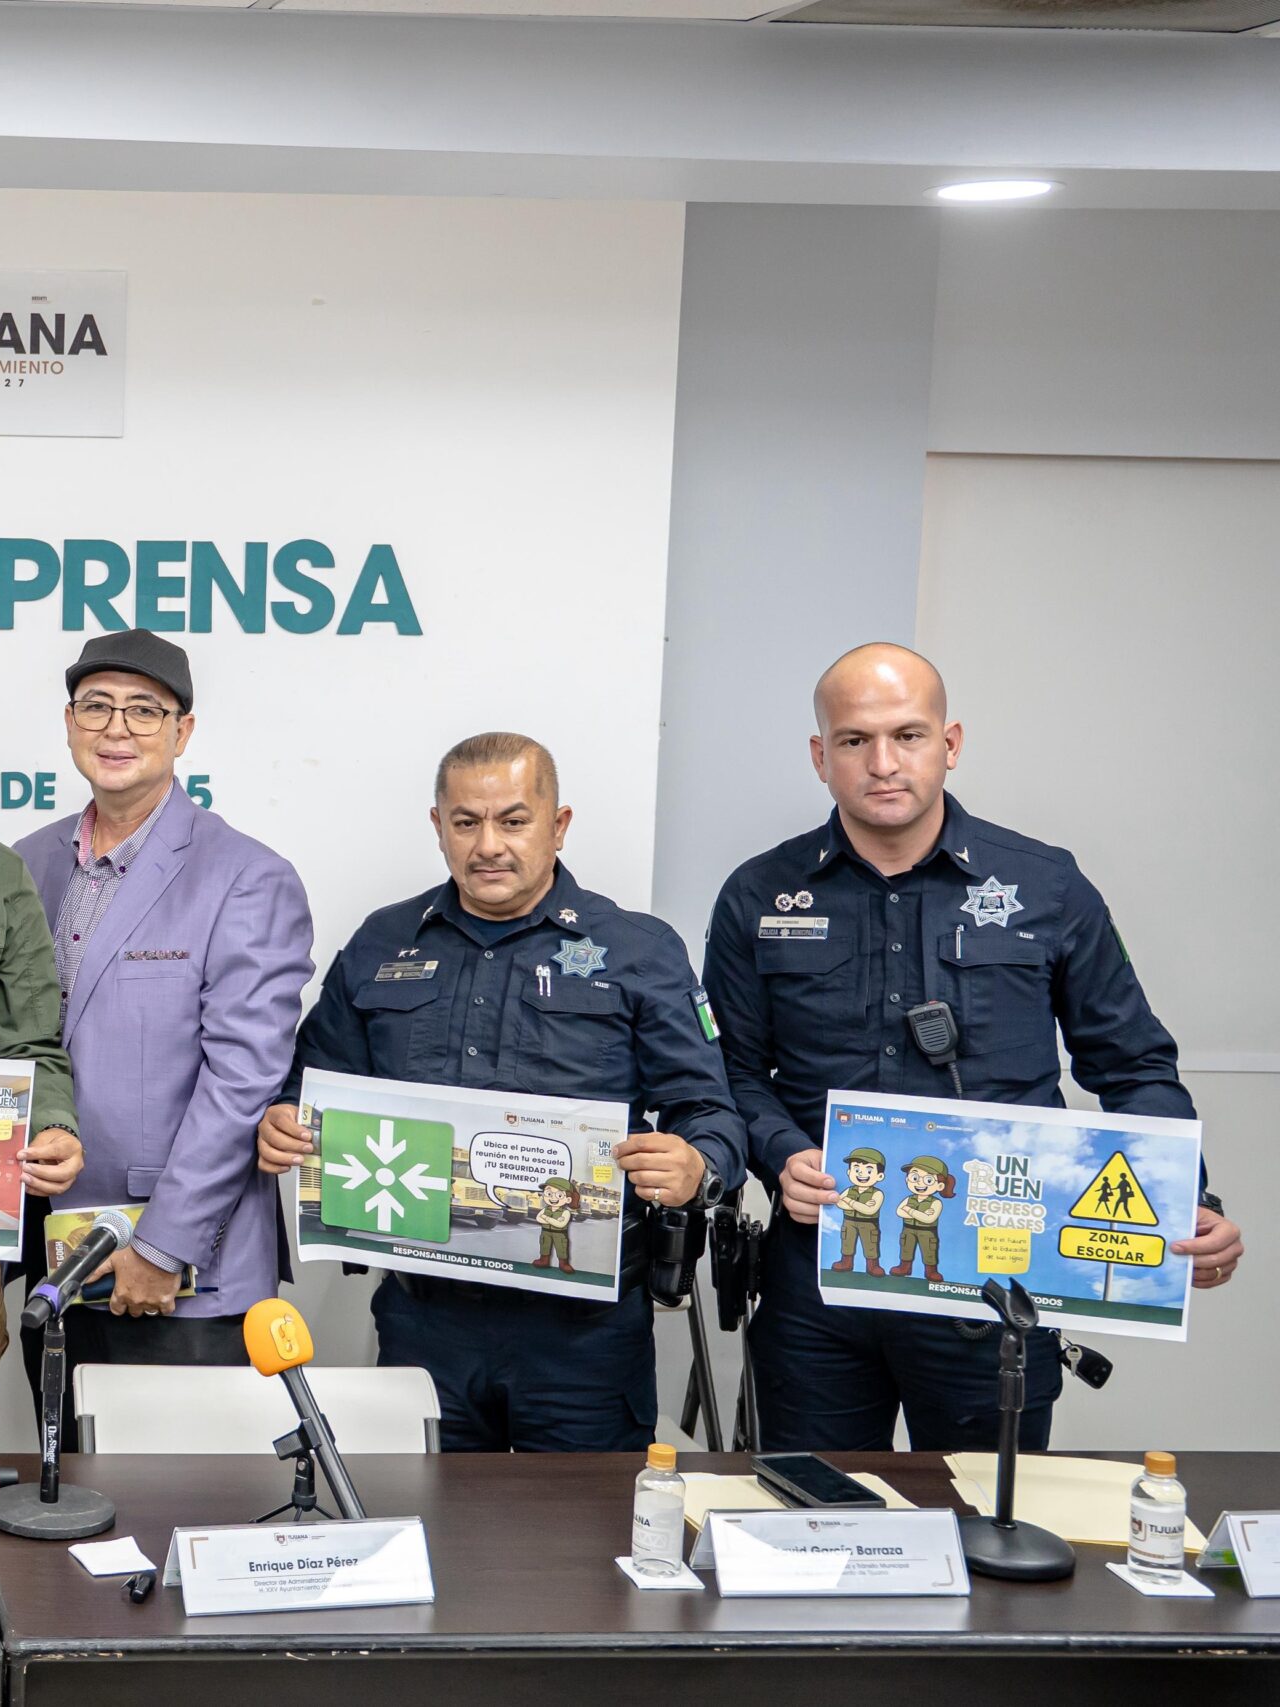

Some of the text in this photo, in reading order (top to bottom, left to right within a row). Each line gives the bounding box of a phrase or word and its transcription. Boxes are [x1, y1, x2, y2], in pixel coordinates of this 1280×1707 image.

[0, 771, 56, 809] DE
[520, 1116, 545, 1124] TIJUANA
[854, 1114, 884, 1123] TIJUANA
[483, 1141, 508, 1149] Ubica
[520, 1146, 544, 1154] punto
[475, 1150, 506, 1159] reunión
[532, 1157, 565, 1166] escuela
[499, 1163, 546, 1174] SEGURIDAD
[996, 1156, 1028, 1177] UN
[499, 1173, 539, 1183] PRIMERO!
[968, 1198, 1045, 1218] REGRESO
[966, 1213, 1043, 1232] A CLASES
[1089, 1232, 1129, 1245] ZONA
[393, 1246, 469, 1264] RESPONSABILIDAD
[471, 1258, 482, 1266] DE
[484, 1260, 514, 1271] TODOS
[1077, 1246, 1144, 1262] ESCOLAR
[856, 1545, 904, 1555] Barraza
[249, 1556, 358, 1573] Enrique Díaz Pérez
